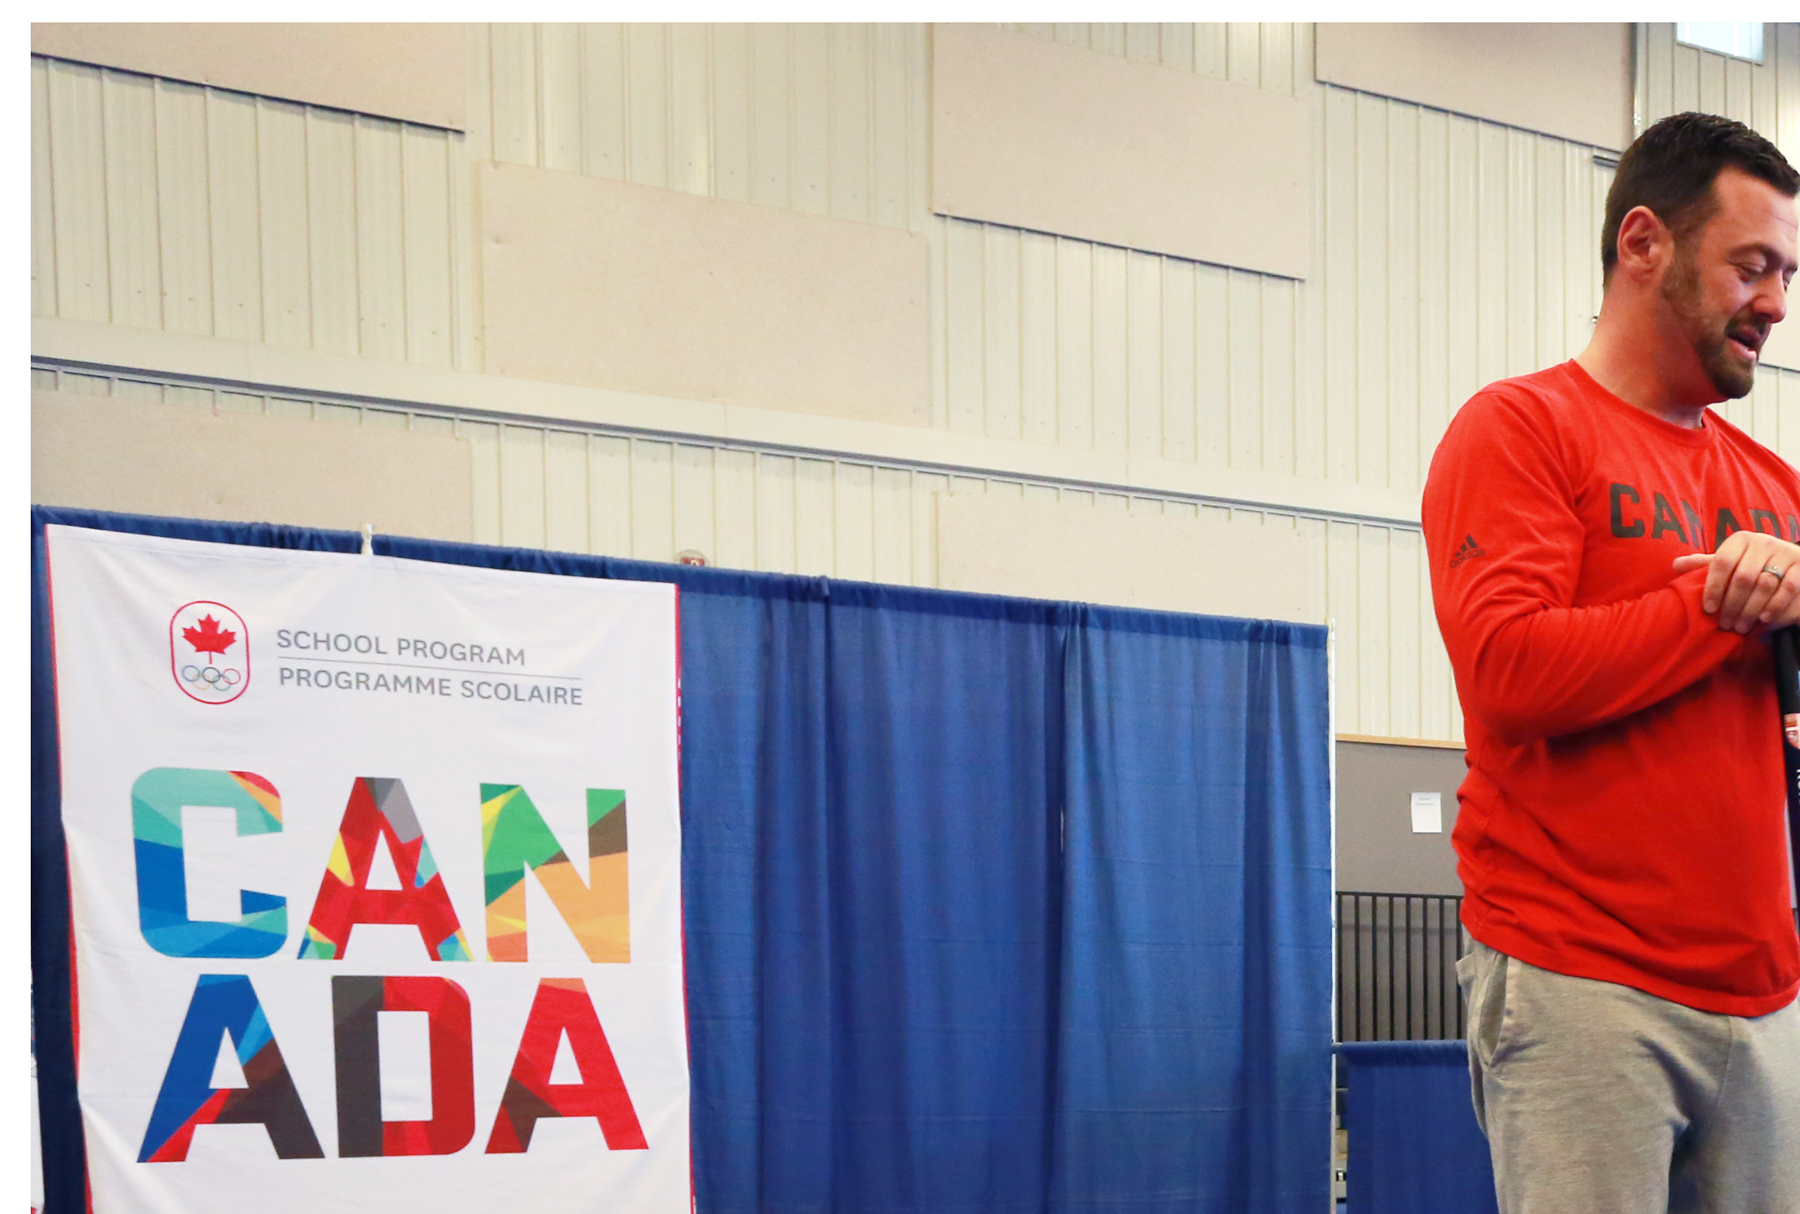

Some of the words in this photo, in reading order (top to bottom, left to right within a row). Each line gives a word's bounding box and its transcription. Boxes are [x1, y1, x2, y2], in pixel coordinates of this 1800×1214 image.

[277, 628, 388, 655] SCHOOL
[397, 637, 526, 666] PROGRAM
[280, 667, 452, 697] PROGRAMME
[461, 680, 583, 706] SCOLAIRE
[131, 766, 632, 964] CAN
[136, 973, 650, 1164] ADA
